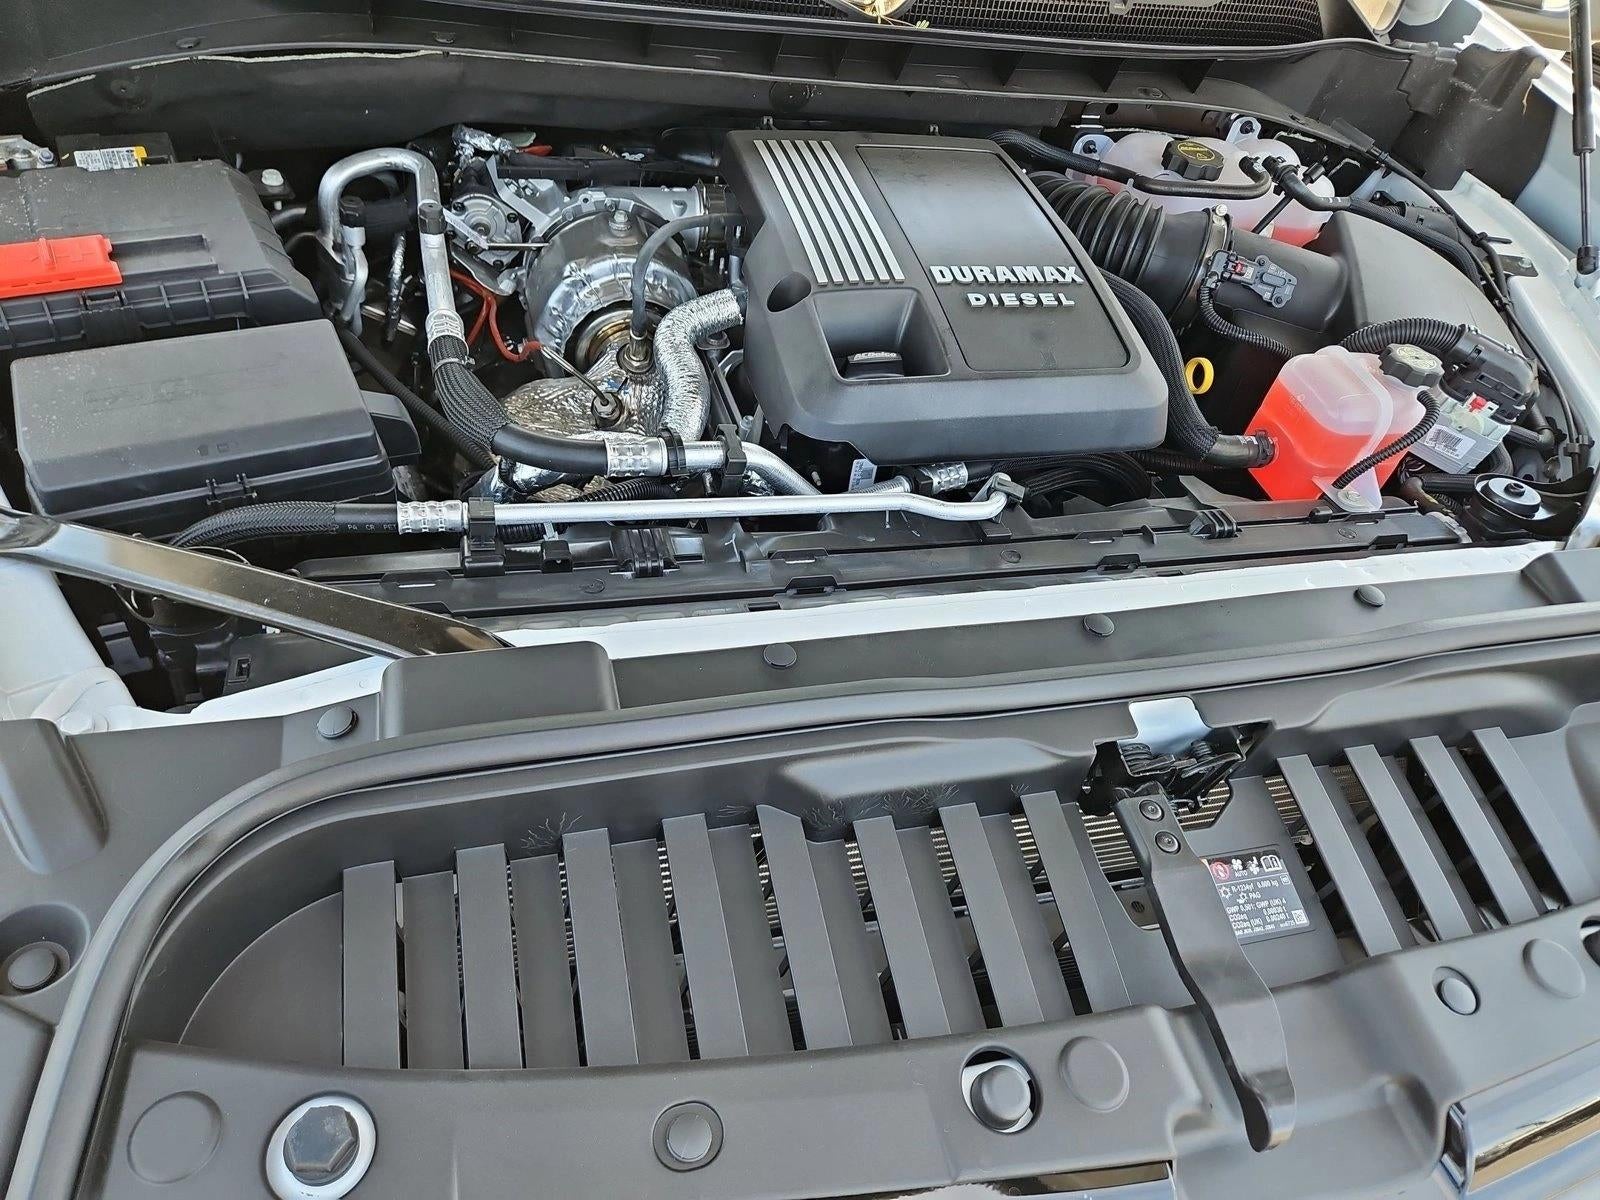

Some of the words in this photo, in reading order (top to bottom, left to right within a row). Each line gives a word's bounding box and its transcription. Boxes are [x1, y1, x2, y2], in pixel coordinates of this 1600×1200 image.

[930, 265, 1085, 284] DURAMAX
[967, 293, 1075, 307] DIESEL
[1234, 870, 1248, 878] AUTO
[1226, 905, 1240, 914] GWP
[1256, 900, 1269, 908] GWP
[1270, 898, 1282, 907] (UK)
[1250, 918, 1263, 927] (UK)
